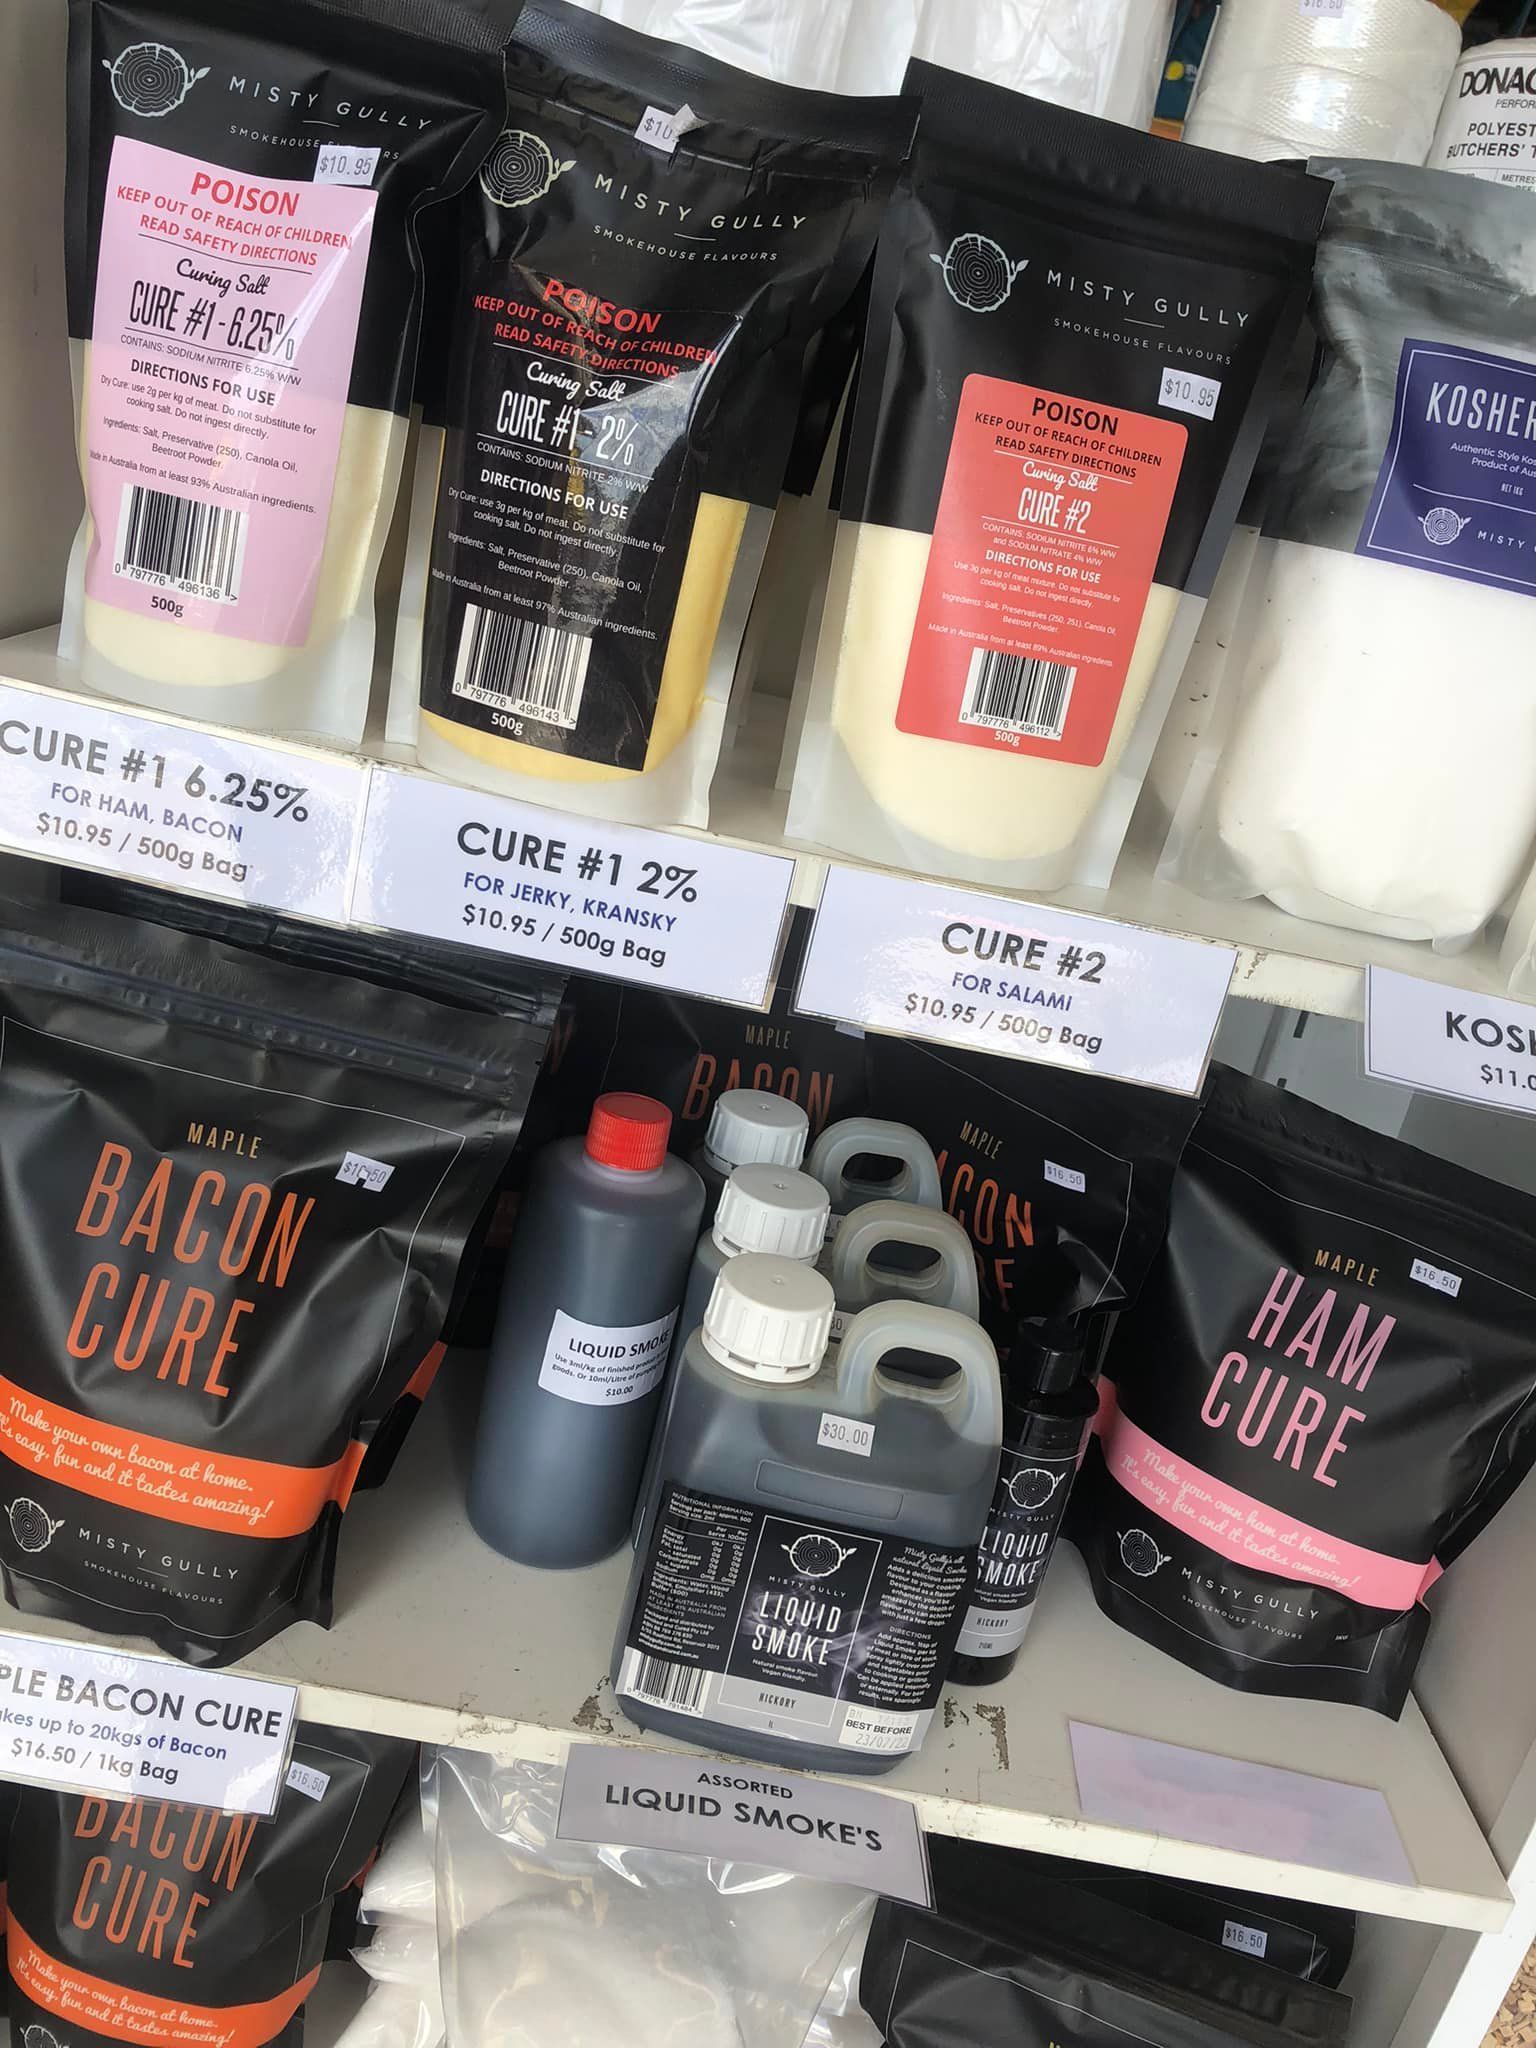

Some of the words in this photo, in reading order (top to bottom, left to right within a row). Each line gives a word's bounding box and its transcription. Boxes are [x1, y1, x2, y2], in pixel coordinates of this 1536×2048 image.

[229, 76, 318, 109] MISTY
[336, 102, 431, 130] GULLY
[230, 125, 320, 148] SMOKEHOUSE
[320, 154, 372, 176] $10.95
[117, 186, 151, 203] KEEP
[154, 196, 188, 216] OUT
[191, 207, 212, 222] OF
[215, 216, 263, 236] REACH
[264, 225, 283, 238] OF
[284, 227, 352, 248] CHILDREN
[190, 172, 300, 216] POISON
[595, 174, 692, 222] MISTY
[711, 215, 806, 231] GULLY
[140, 214, 180, 236] READ
[183, 228, 238, 254] SAFETY
[240, 244, 318, 266] DIRECTIONS
[593, 225, 697, 261] SMOKEHOUSE
[704, 252, 778, 262] FLAVOURS
[176, 258, 231, 297] Curing
[236, 274, 270, 295] Salt
[1047, 269, 1135, 306] MISTY
[1155, 299, 1249, 328] GULLY
[130, 280, 185, 332] CURE
[183, 298, 216, 340] #1
[228, 306, 298, 360] 6.25%
[474, 294, 505, 312] KEEP
[507, 302, 539, 321] OUT
[542, 311, 564, 329] OF
[565, 319, 617, 349] REACH
[620, 340, 639, 352] OF
[641, 342, 719, 364] CHILDREN
[542, 278, 662, 334] POISON
[494, 323, 531, 344] READ
[533, 333, 589, 361] SAFETY
[590, 353, 680, 379] DIRECTIONS
[1054, 318, 1149, 349] SMOKEHOUSE
[1158, 343, 1232, 365] FLAVOURS
[130, 359, 208, 389] DIRECTIONS
[213, 379, 242, 397] FOR
[247, 387, 276, 406] USE
[526, 362, 582, 400] Curing
[585, 380, 626, 402] Salt
[1164, 378, 1215, 408] $10.95
[496, 390, 550, 443] CURE
[550, 404, 581, 450] #1
[596, 416, 639, 466] 2%
[975, 412, 1003, 427] KEEP
[1006, 419, 1030, 433] OUT
[1033, 426, 1049, 438] OF
[1051, 430, 1088, 448] REACH
[1091, 440, 1106, 451] OF
[1107, 443, 1162, 467] CHILDREN
[1032, 397, 1119, 436] POISON
[995, 435, 1026, 451] READ
[1028, 443, 1069, 463] SAFETY
[1071, 453, 1137, 478] DIRECTIONS
[1450, 442, 1495, 458] Authentic
[1497, 449, 1520, 462] Style
[1471, 456, 1508, 472] Product
[1509, 464, 1519, 474] of
[480, 468, 562, 502] DIRECTIONS
[565, 491, 595, 512] FOR
[600, 501, 629, 520] USE
[1023, 461, 1066, 490] Curing
[1068, 471, 1098, 492] Salt
[1017, 487, 1064, 527] CURE
[1064, 499, 1092, 534] #2
[1478, 530, 1526, 550] MISTY
[985, 550, 1053, 574] DIRECTIONS
[1056, 565, 1078, 579] FOR
[1080, 570, 1101, 584] USE
[151, 595, 184, 617] 500g
[490, 712, 524, 736] 500g
[994, 730, 1021, 747] 500g
[0, 719, 109, 776] CURE
[120, 748, 166, 789] #1
[184, 765, 309, 823] 6.25%
[51, 782, 92, 807] FOR
[98, 794, 154, 824] HAM,
[162, 808, 243, 843] BACON
[36, 811, 112, 848] $10.95
[137, 837, 194, 869] 500g
[201, 852, 248, 882] Bag
[456, 821, 566, 874] CURE
[577, 847, 622, 886] #1
[636, 861, 698, 902] 2%
[463, 871, 504, 896] FOR
[509, 881, 576, 915] JERKY,
[582, 898, 678, 932] KRANSKY
[462, 904, 536, 937] $10.95
[559, 926, 616, 957] 500g
[622, 939, 666, 968] Bag
[941, 922, 1048, 972] CURE
[1056, 945, 1107, 984] #2
[951, 972, 991, 995] FOR
[996, 980, 1072, 1012] SALAMI
[904, 993, 977, 1025] $10.95
[997, 1014, 1052, 1044] 500g
[1059, 1026, 1103, 1054] Bag
[186, 1121, 262, 1159] MAPLE
[960, 1120, 1004, 1159] MAPLE
[75, 1141, 316, 1288] BACON
[1314, 1248, 1379, 1287] MAPLE
[1414, 1264, 1457, 1291] $16.50
[66, 1262, 255, 1398] CURE
[569, 1338, 626, 1358] LIQUID
[629, 1329, 670, 1357] SMOKE
[1248, 1266, 1397, 1392] HAM
[822, 1422, 869, 1446] $30.00
[1201, 1351, 1366, 1488] CURE
[10, 1396, 51, 1432] Make
[52, 1424, 89, 1449] your
[92, 1441, 122, 1460] own
[129, 1444, 176, 1475] bacon
[179, 1461, 200, 1481] at
[203, 1464, 252, 1491] home.
[79, 1527, 147, 1559] MISTY
[161, 1555, 239, 1580] GULLY
[980, 1526, 1049, 1558] LIQUID
[760, 1591, 841, 1633] LIQUID
[1182, 1567, 1242, 1600] MISTY
[1254, 1594, 1320, 1620] GULLY
[752, 1624, 833, 1665] SMOKE
[56, 1674, 184, 1722] BACON
[195, 1699, 282, 1738] CURE
[758, 1693, 795, 1709] HICKORY
[39, 1718, 62, 1734] up
[67, 1722, 84, 1736] to
[89, 1724, 142, 1749] 20kgs
[147, 1734, 166, 1749] of
[170, 1740, 226, 1761] Bacon
[846, 1719, 871, 1731] BEST
[874, 1724, 913, 1735] BEFORE
[11, 1737, 76, 1764] $16.50
[98, 1752, 132, 1777] 1kg
[139, 1760, 178, 1784] Bag
[290, 1769, 325, 1792] $16.50
[697, 1773, 793, 1800] ASSORTED
[606, 1785, 721, 1817] LIQUID
[734, 1802, 883, 1852] SMOKE'S
[72, 1855, 209, 1969] CURE
[1224, 1926, 1263, 1949] $16.50
